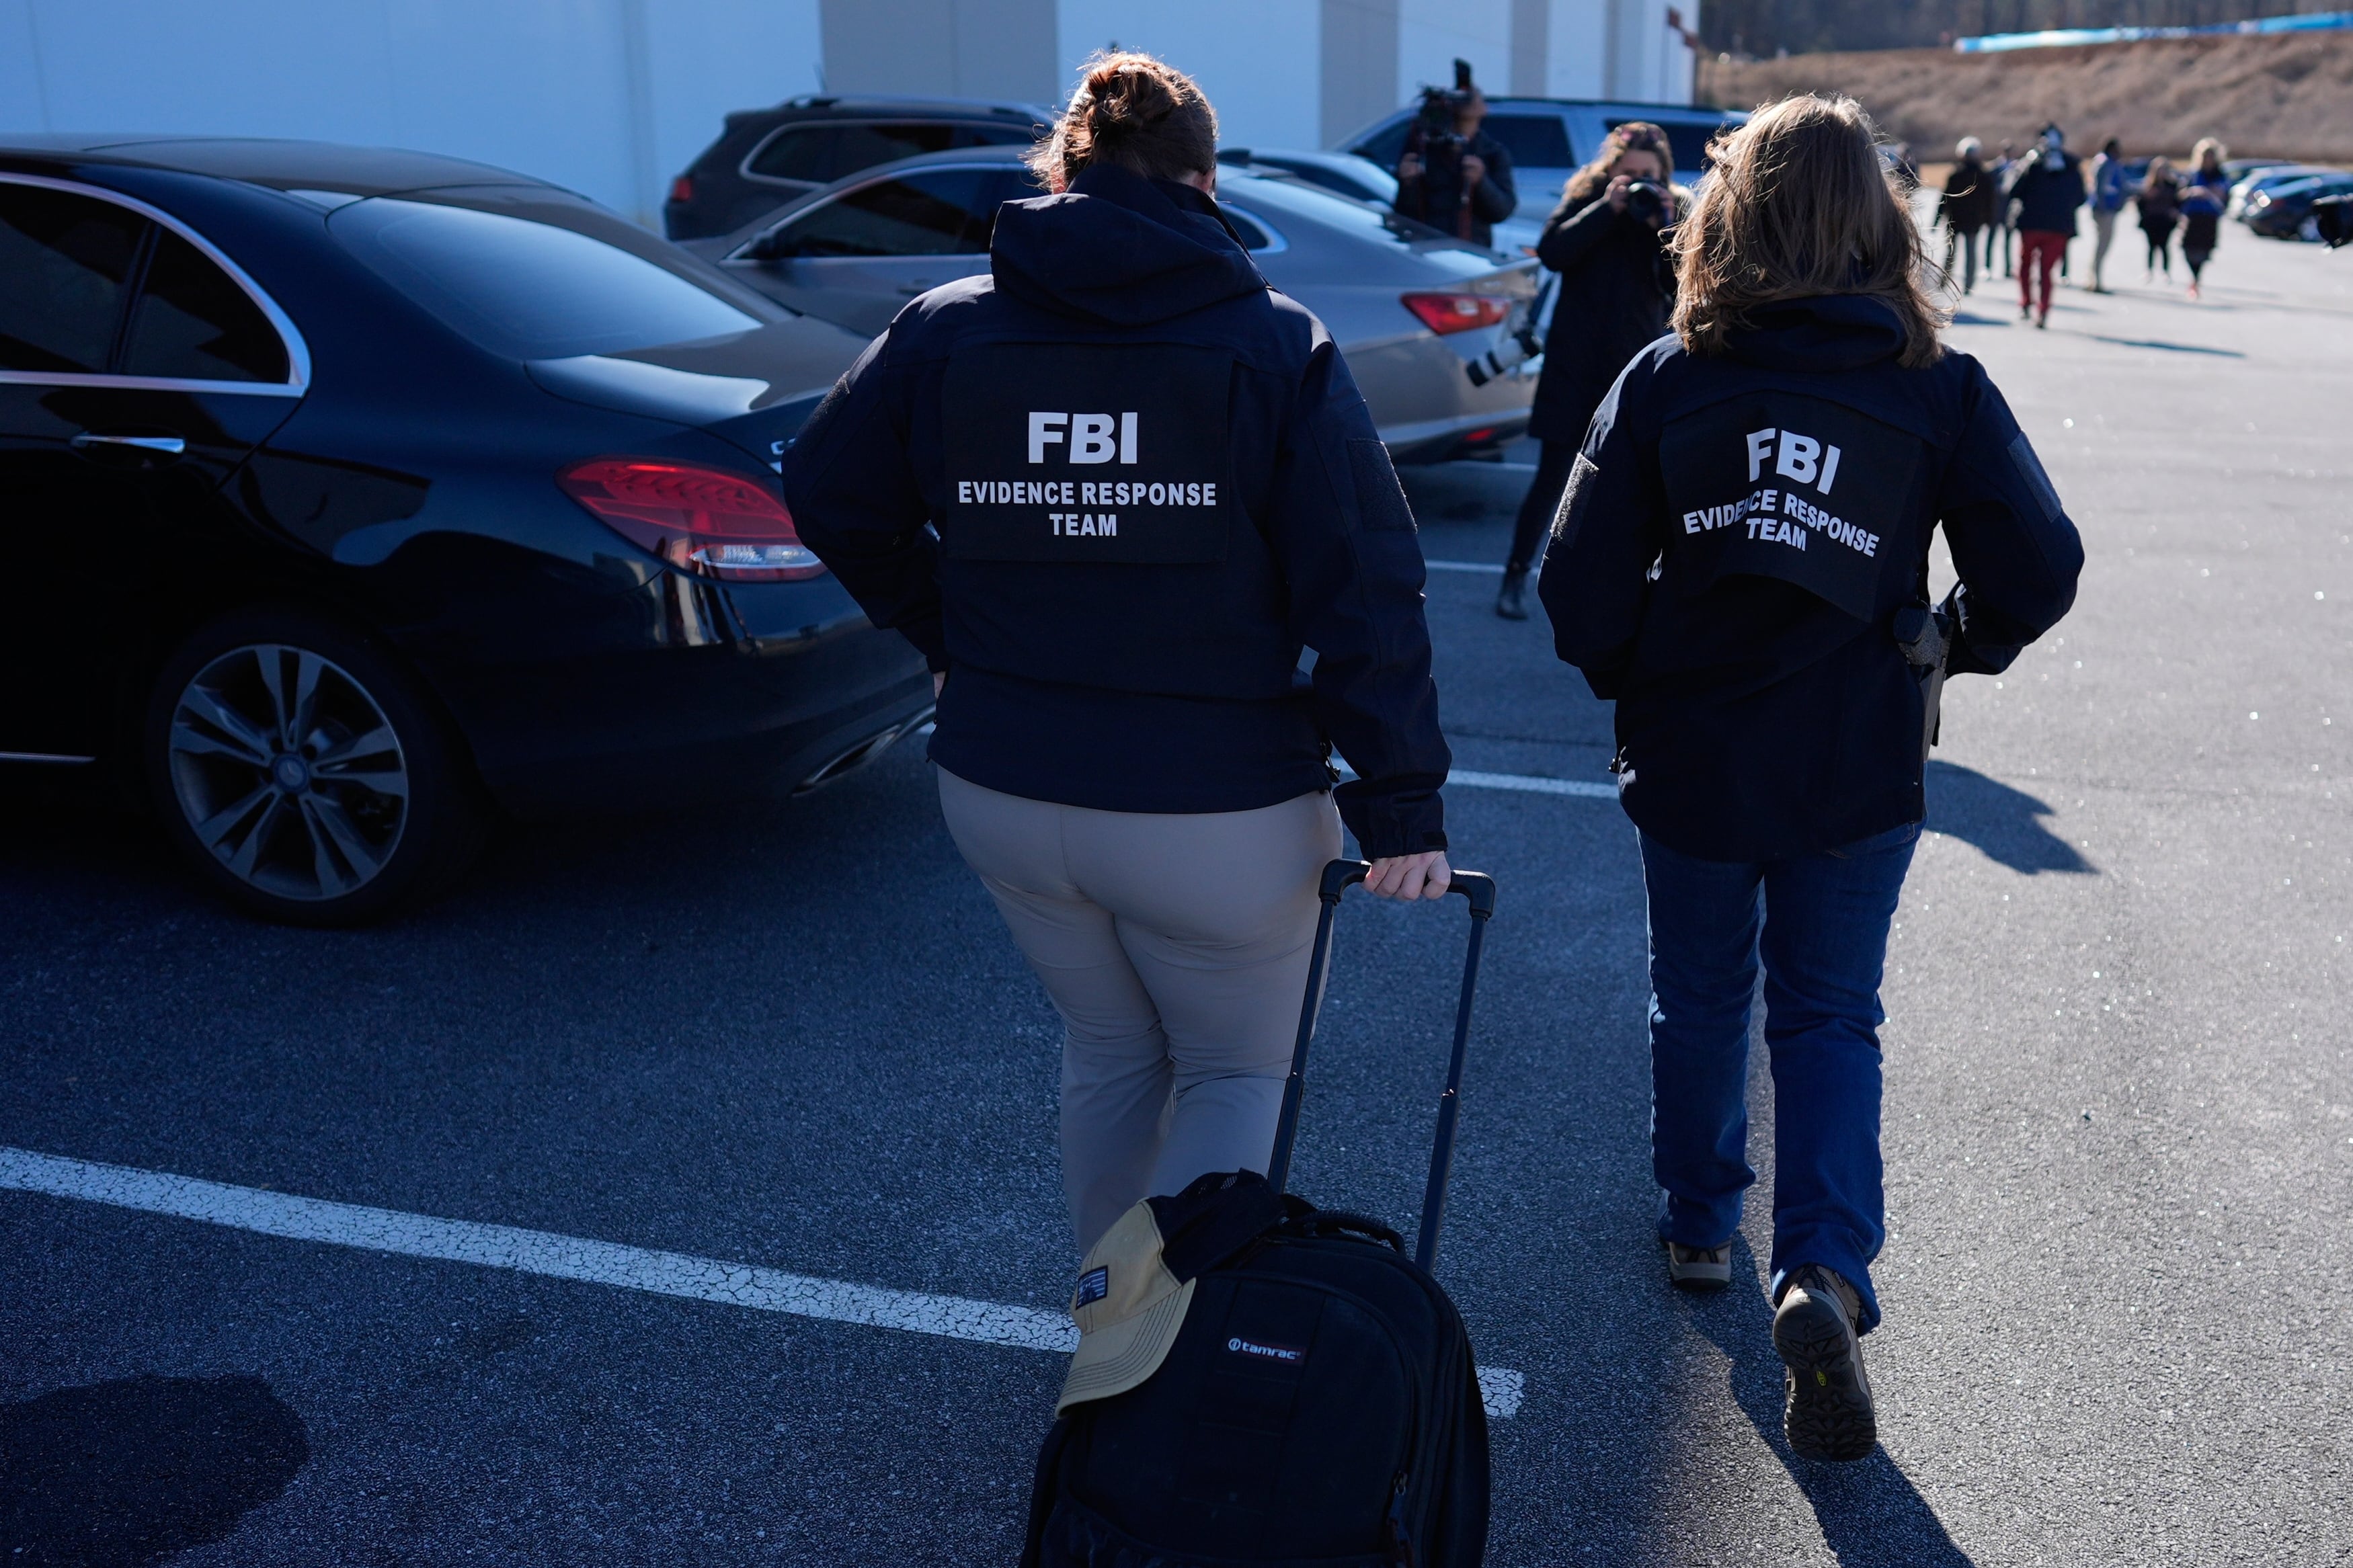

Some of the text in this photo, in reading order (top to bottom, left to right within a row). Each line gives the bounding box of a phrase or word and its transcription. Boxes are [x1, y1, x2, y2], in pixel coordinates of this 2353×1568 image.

[1028, 411, 1138, 464] FBI
[1746, 427, 1841, 495] FBI
[958, 481, 1216, 506] EVIDENCE RESPONSE
[1049, 513, 1117, 536] TEAM
[1683, 489, 1880, 557] EVIDENCE RESPONSE
[1745, 518, 1806, 552] TEAM
